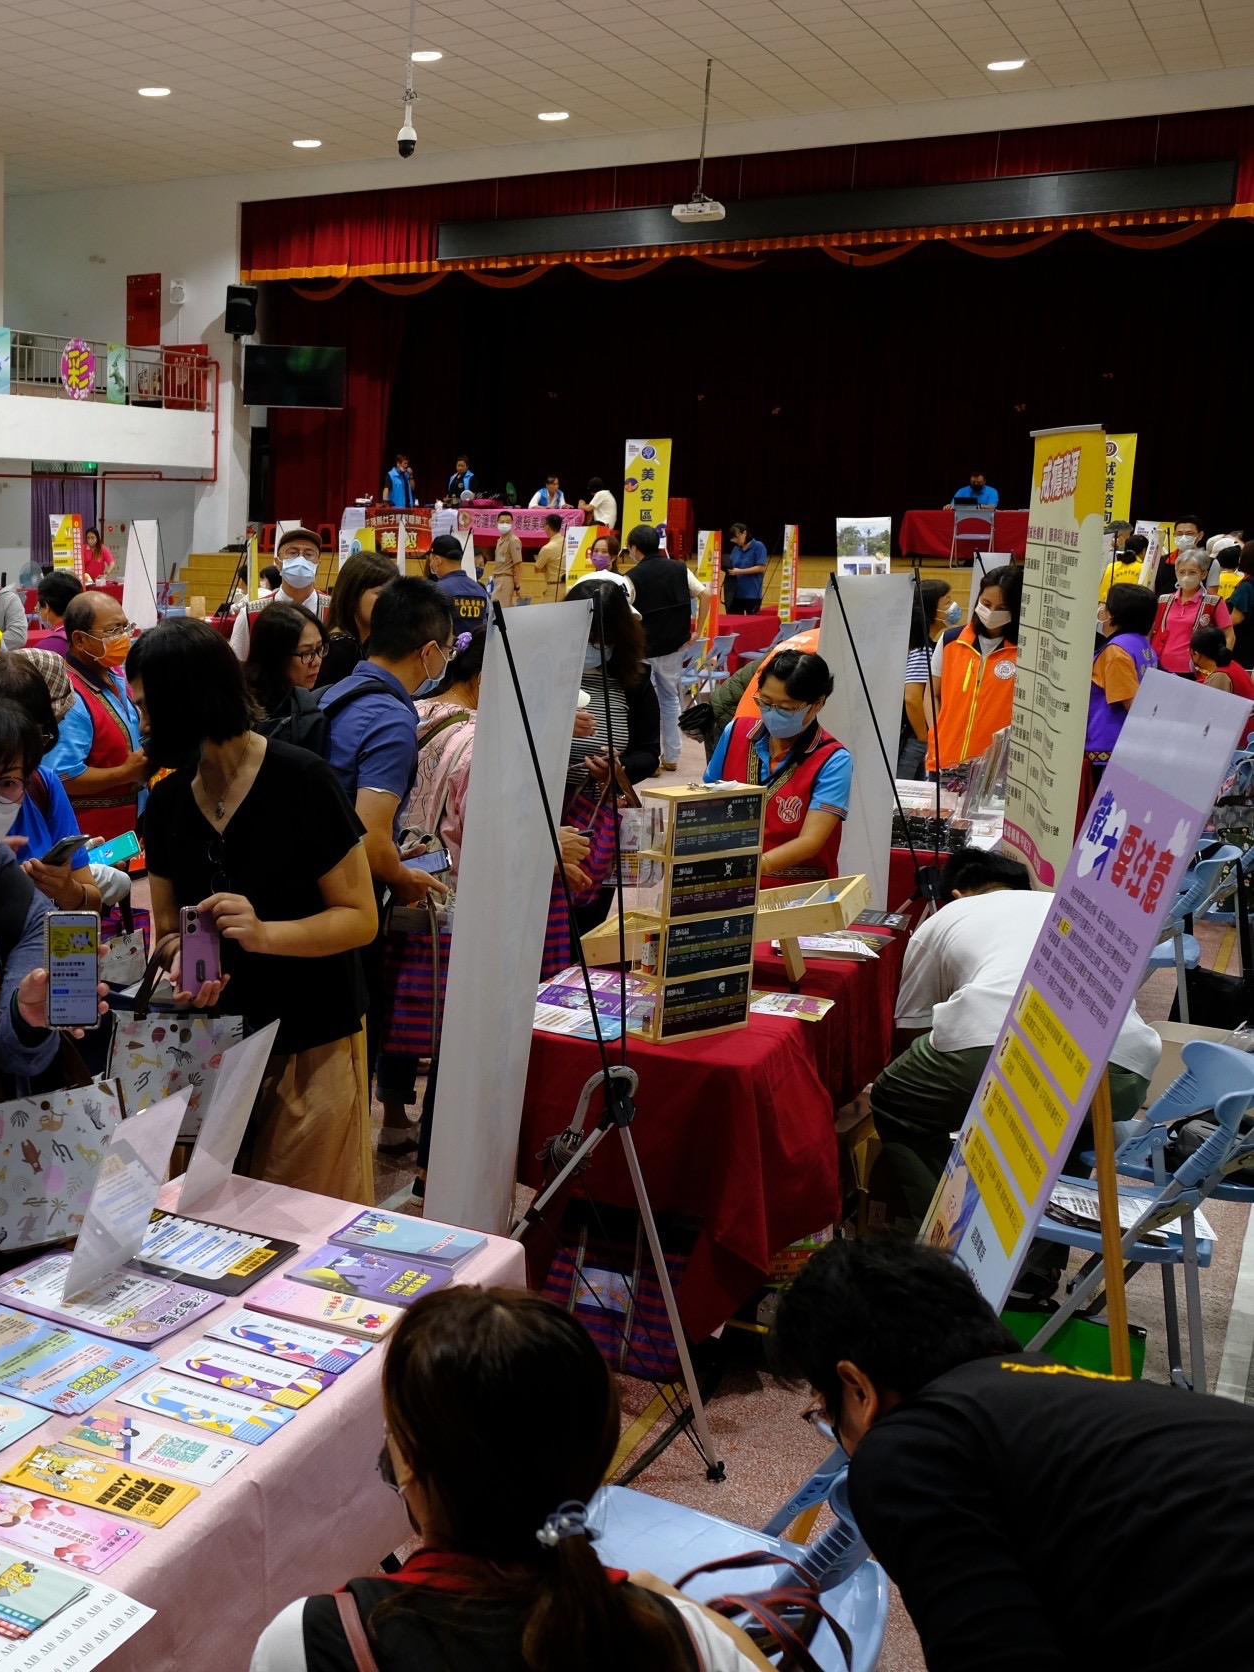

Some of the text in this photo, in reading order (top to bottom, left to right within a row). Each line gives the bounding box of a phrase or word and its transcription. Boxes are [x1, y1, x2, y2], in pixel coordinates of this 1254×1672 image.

[67, 350, 90, 389] 彩
[639, 467, 655, 522] 美容區
[459, 605, 481, 618] CID
[999, 1036, 1010, 1057] 2
[153, 1290, 212, 1328] 求職防騙
[153, 1436, 192, 1458] 友善
[176, 1438, 209, 1464] 職場
[112, 1477, 156, 1511] 不歧視
[146, 1483, 175, 1505] 職場
[101, 1592, 117, 1605] A10
[86, 1604, 102, 1617] A10
[123, 1605, 139, 1618] A10
[71, 1616, 87, 1629] A10
[108, 1617, 124, 1631] A10
[55, 1628, 71, 1642] A10
[93, 1629, 110, 1643] A10
[0, 1643, 16, 1656] A10
[39, 1641, 55, 1655] A10
[78, 1642, 94, 1656] A10
[23, 1654, 40, 1668] A10
[62, 1654, 78, 1668] A10
